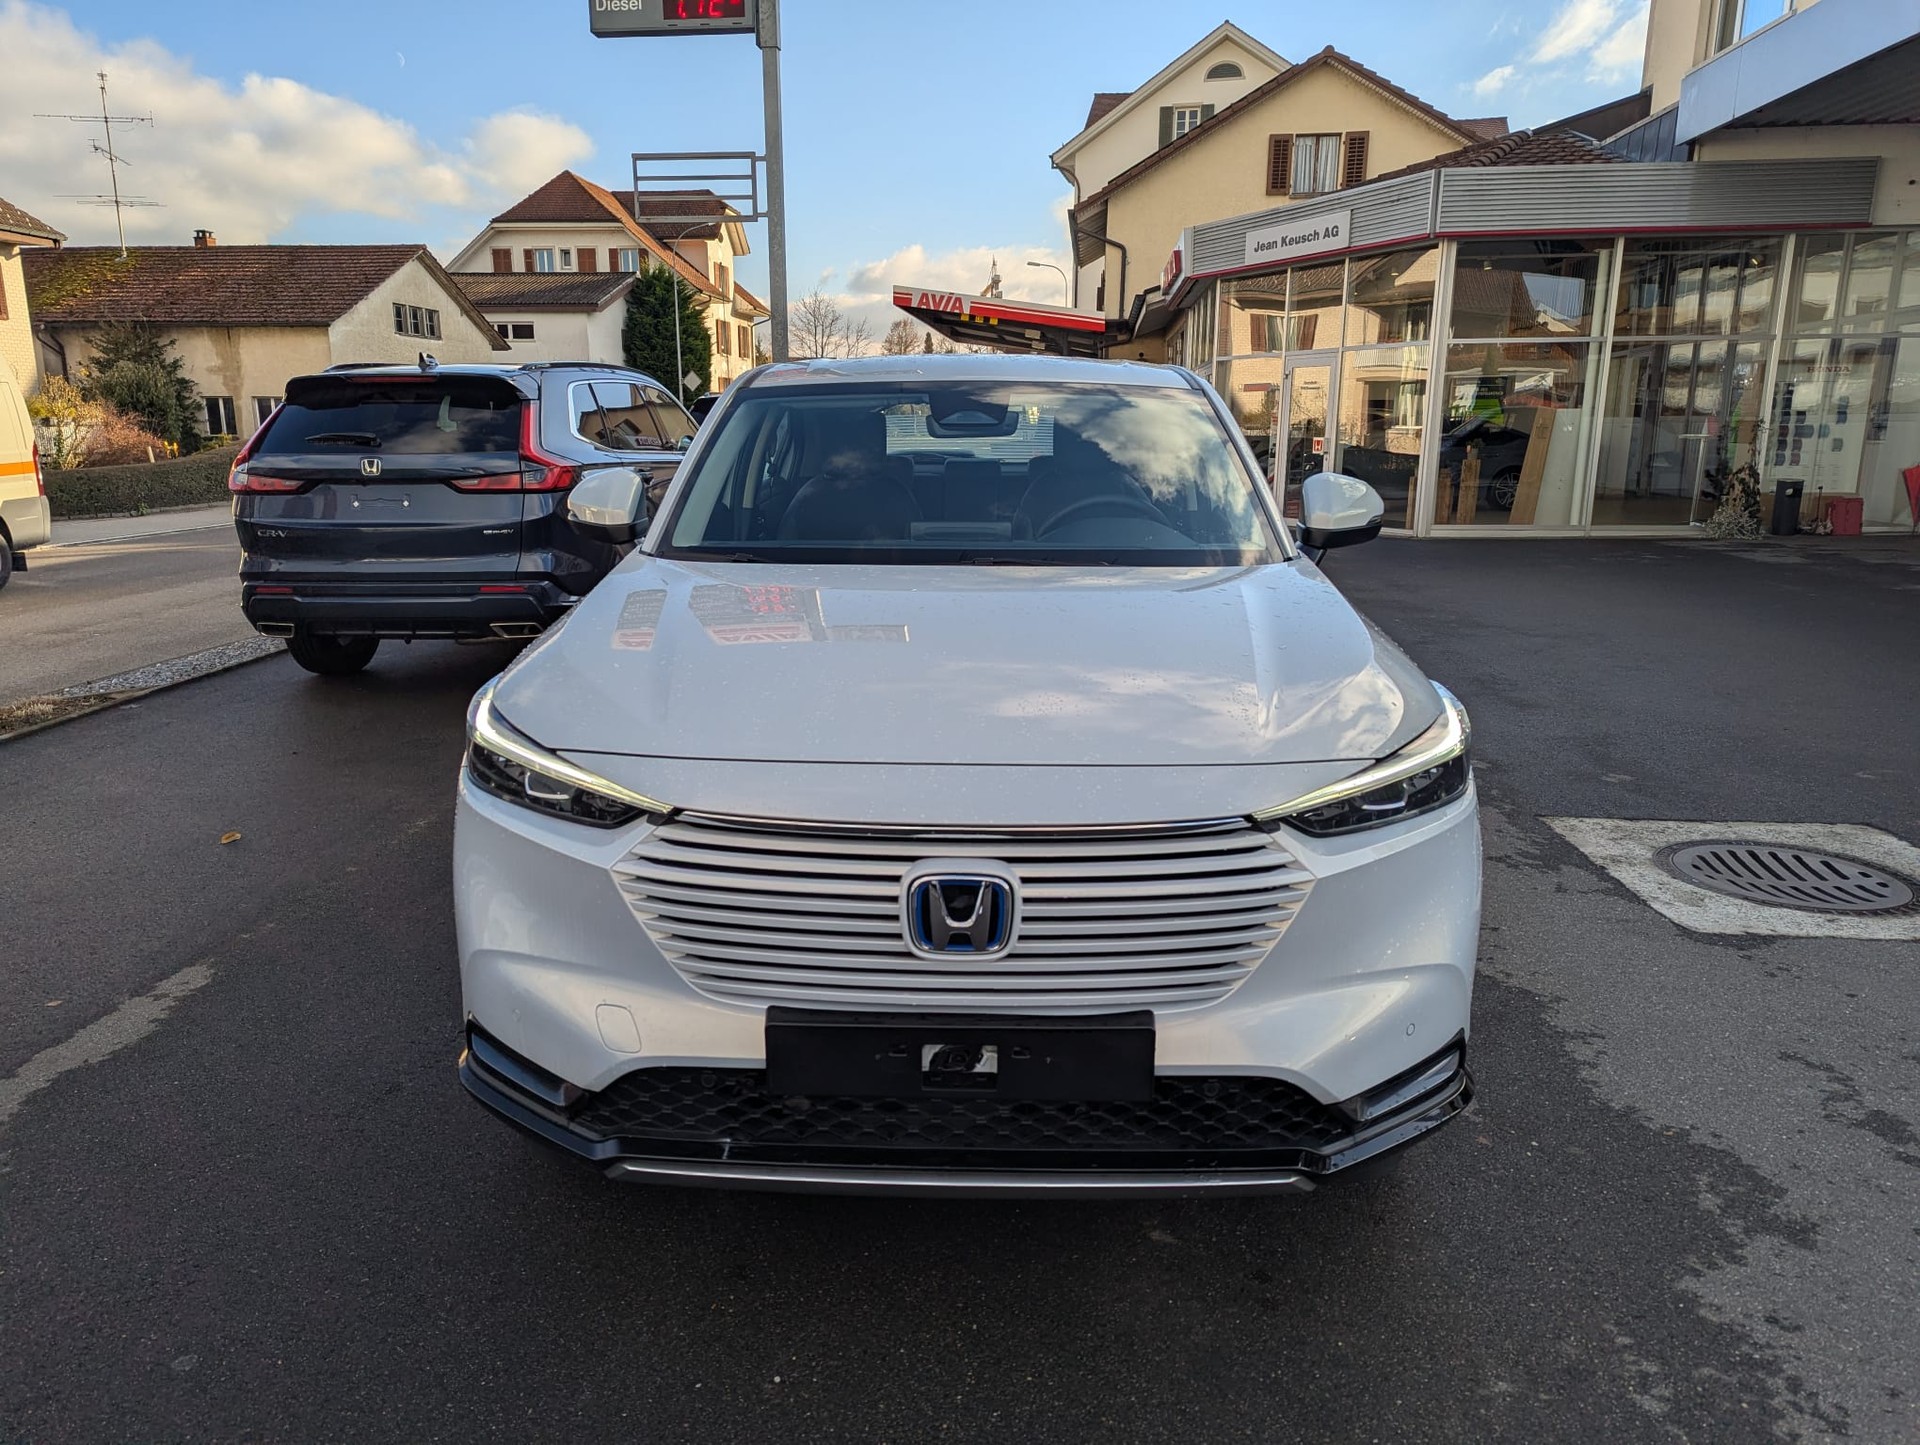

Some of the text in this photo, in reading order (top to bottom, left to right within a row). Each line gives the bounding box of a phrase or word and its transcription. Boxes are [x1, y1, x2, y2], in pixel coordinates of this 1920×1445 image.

[596, 0, 642, 11] Diesel
[1254, 224, 1340, 253] Jean Keusch AG
[917, 292, 965, 314] AVIA
[1807, 365, 1850, 373] HONDA
